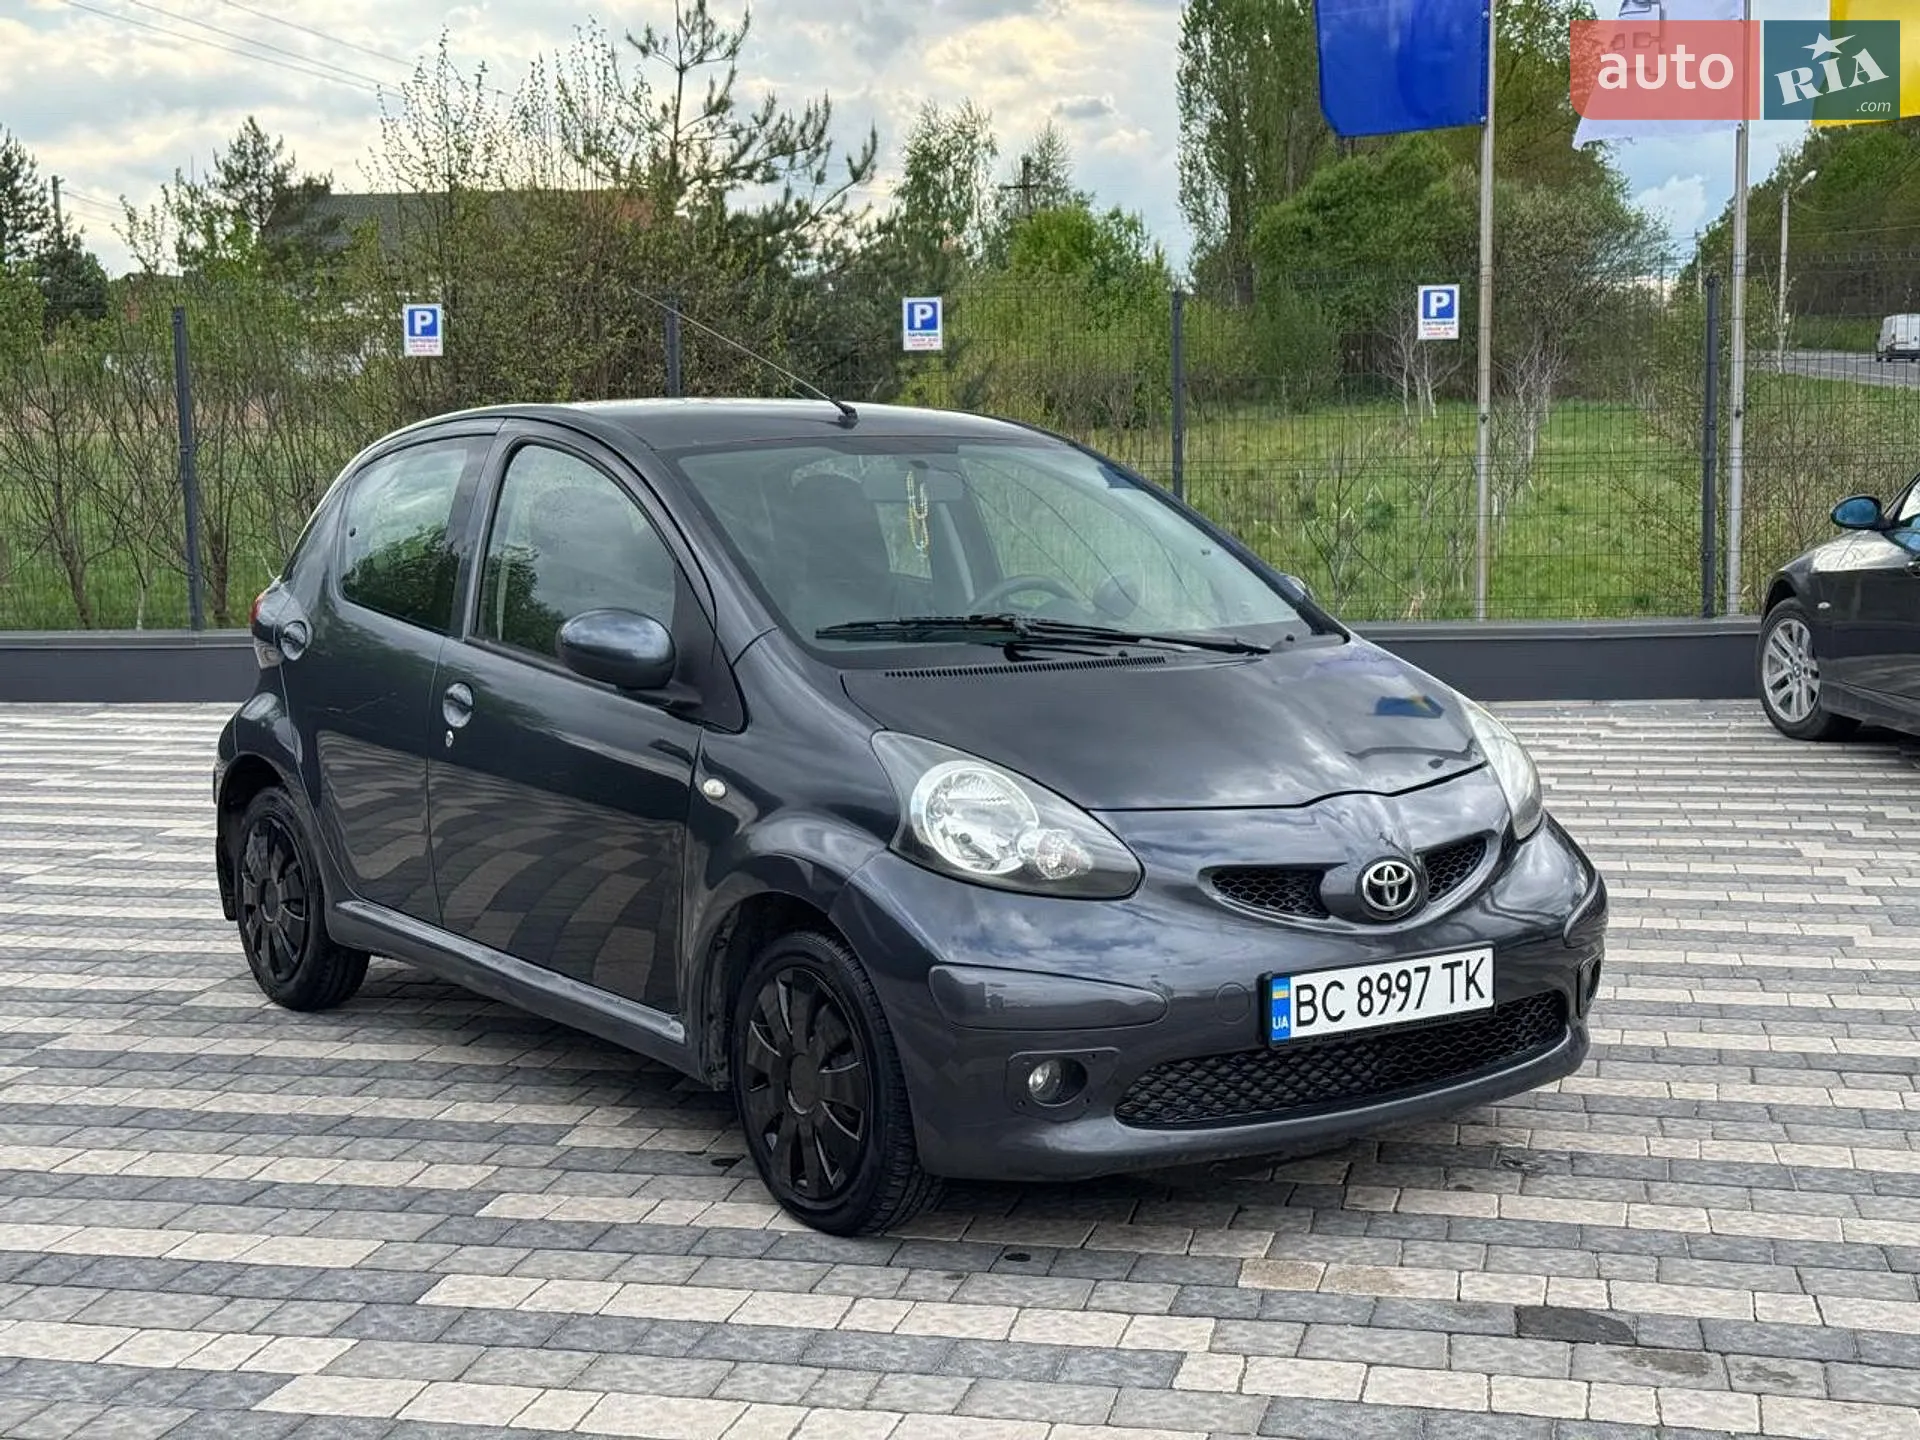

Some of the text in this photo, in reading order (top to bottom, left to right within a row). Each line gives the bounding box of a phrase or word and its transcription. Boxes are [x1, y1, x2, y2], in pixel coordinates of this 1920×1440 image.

[914, 304, 933, 329] P
[1430, 291, 1450, 317] P
[414, 310, 433, 335] P
[1295, 957, 1486, 1027] BC 8997 TK
[1272, 1016, 1289, 1030] UA
